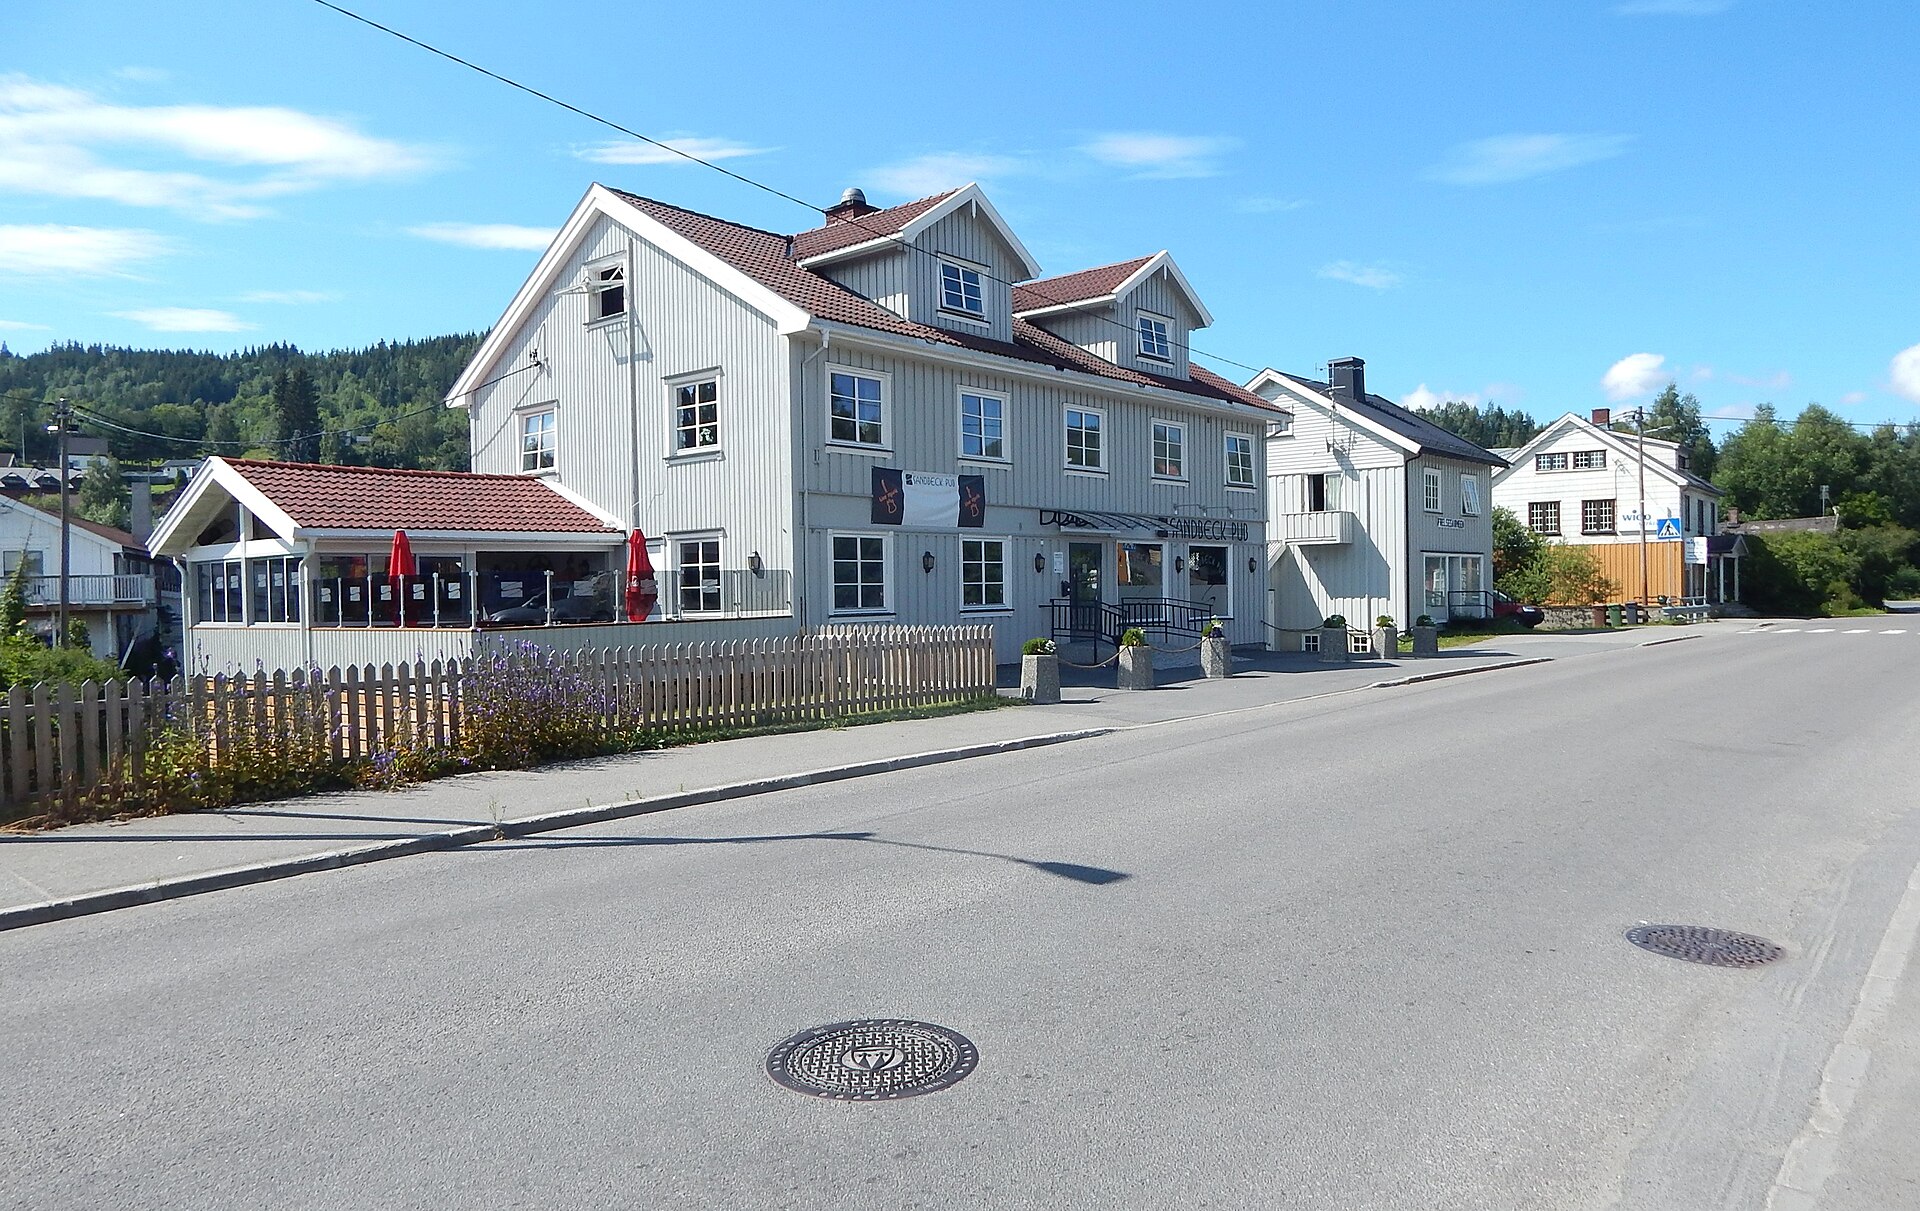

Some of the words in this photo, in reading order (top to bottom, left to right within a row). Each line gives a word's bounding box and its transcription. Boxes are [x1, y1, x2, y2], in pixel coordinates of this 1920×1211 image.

[912, 475, 943, 487] SANDBECK
[945, 478, 956, 488] PUB
[1169, 517, 1227, 541] SANDBECK
[1231, 521, 1249, 542] PUB
